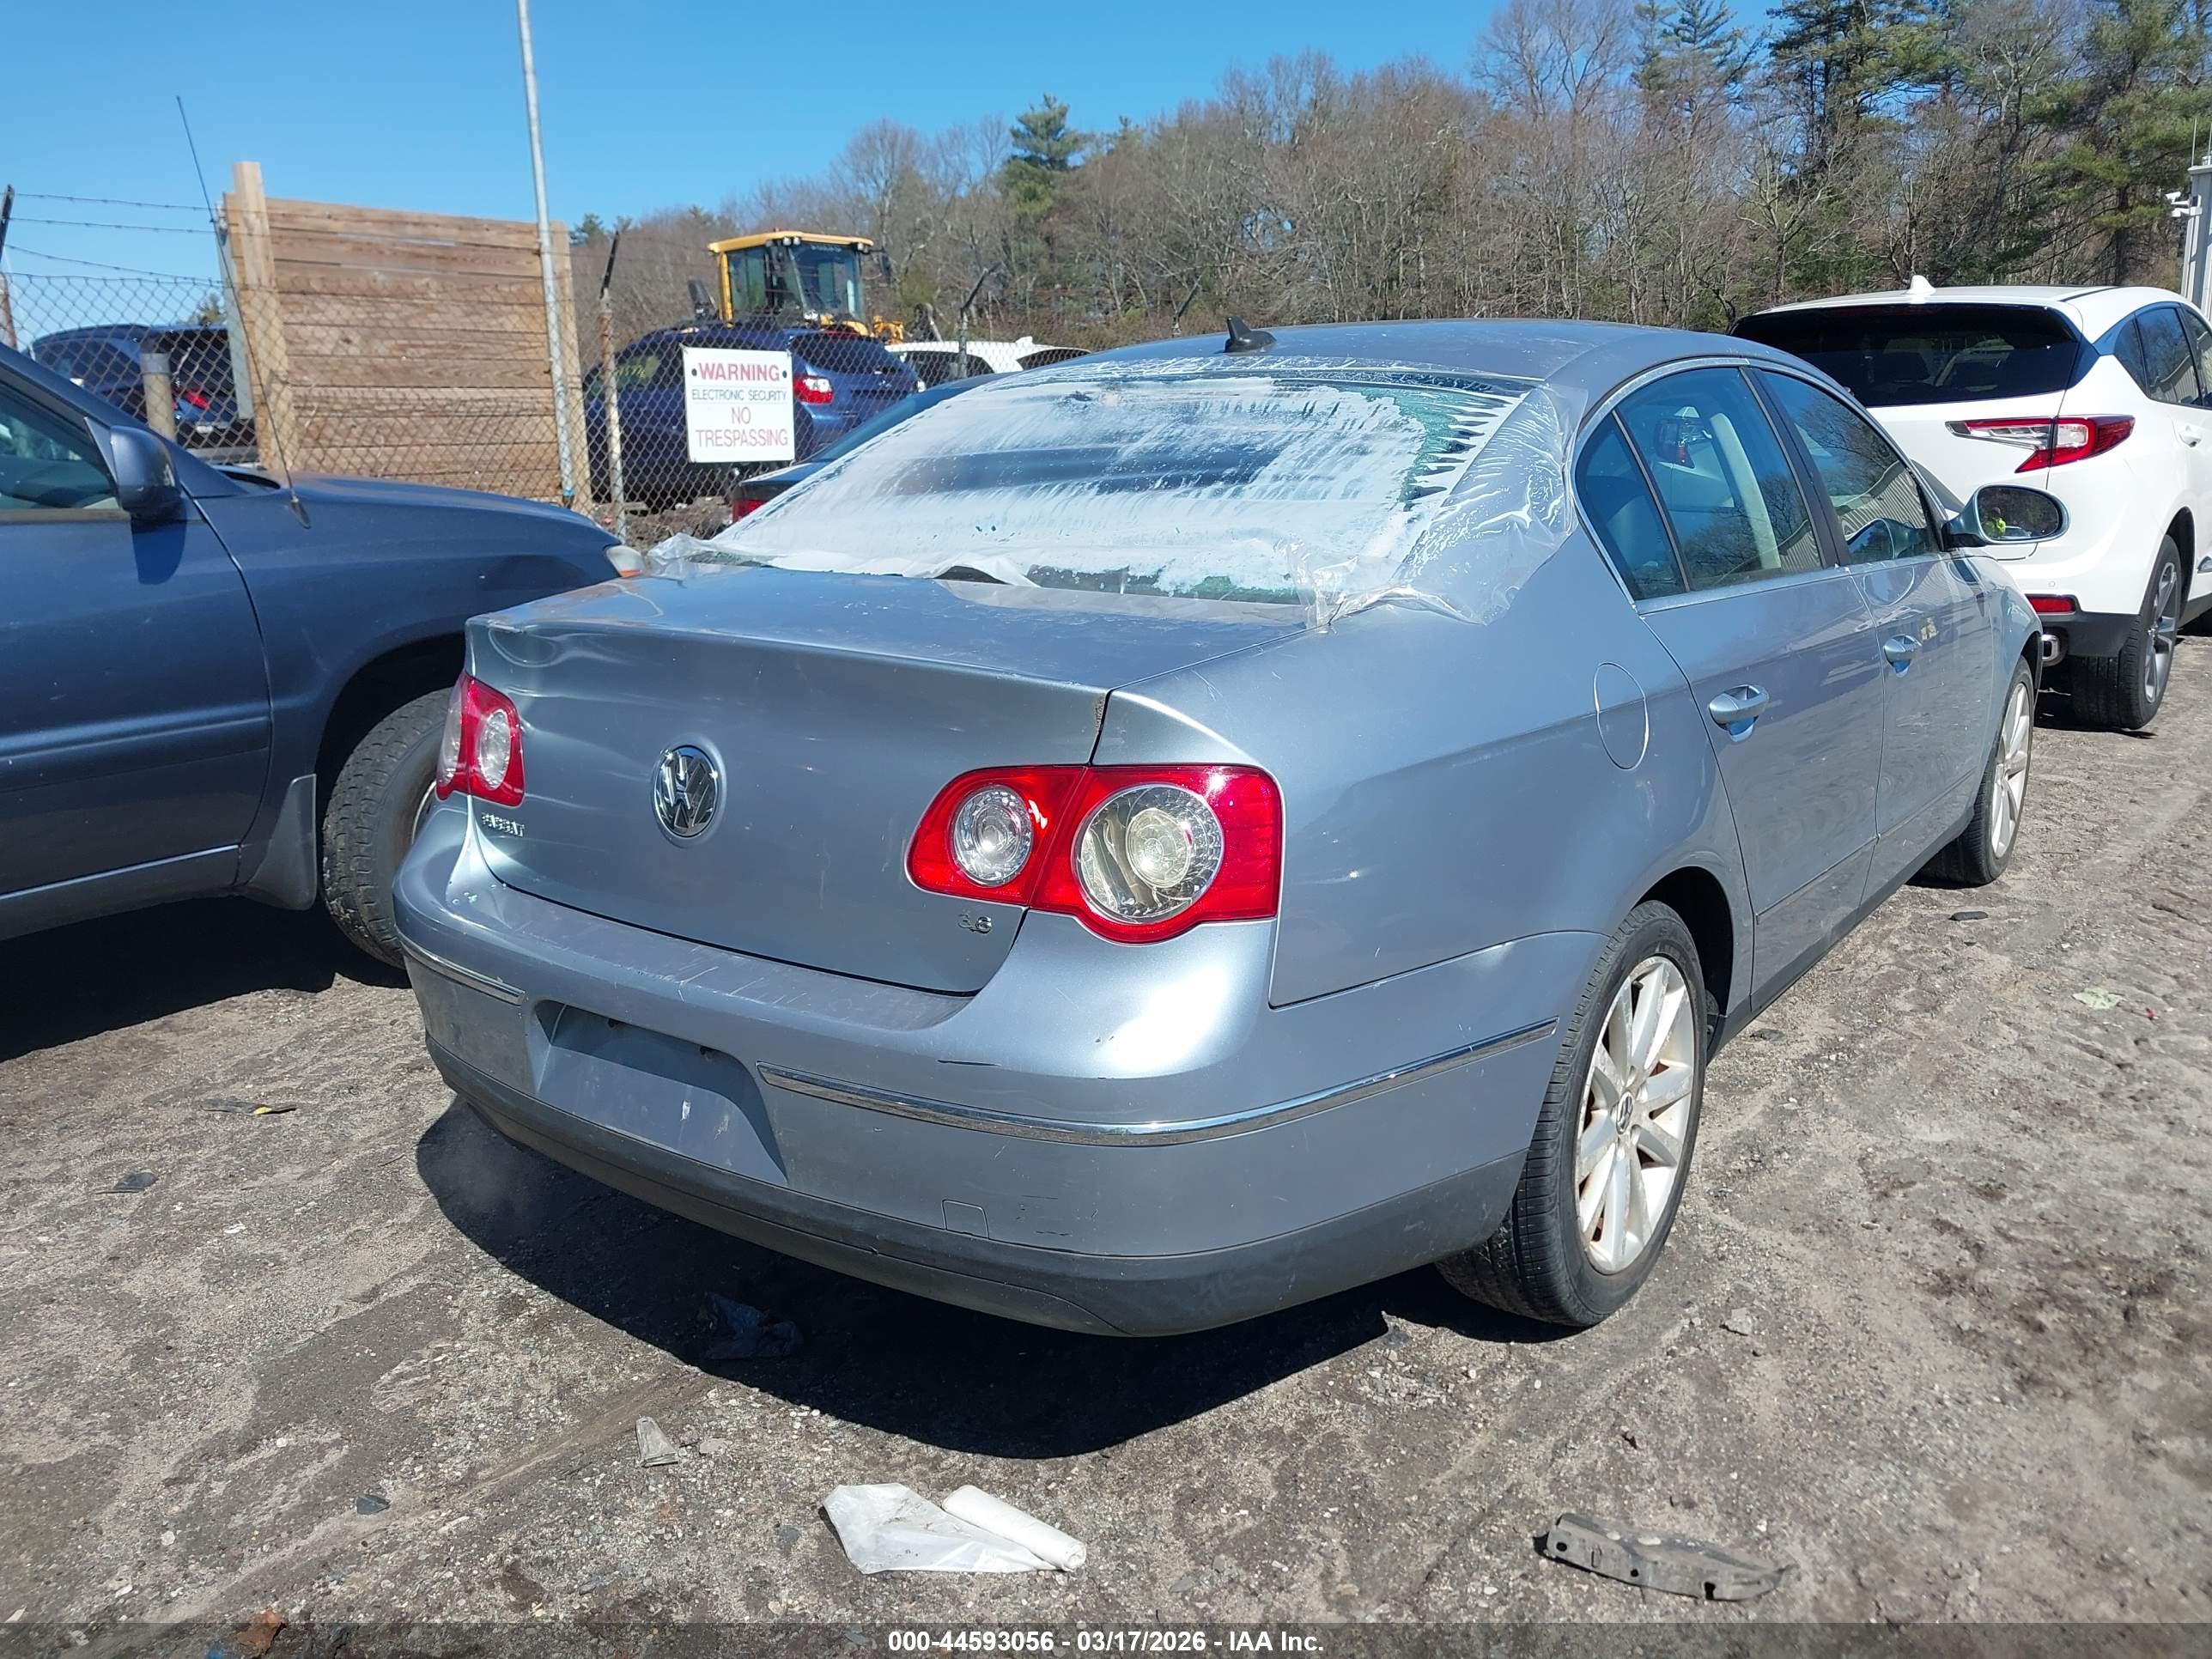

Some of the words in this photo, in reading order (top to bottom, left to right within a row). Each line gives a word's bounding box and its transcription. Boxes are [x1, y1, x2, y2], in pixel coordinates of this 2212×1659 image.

[699, 362, 780, 381] WARNING
[691, 388, 744, 401] ELECTRONIC
[748, 389, 787, 402] SECURITY
[731, 406, 751, 425] NO
[696, 428, 788, 447] TRESPASSING
